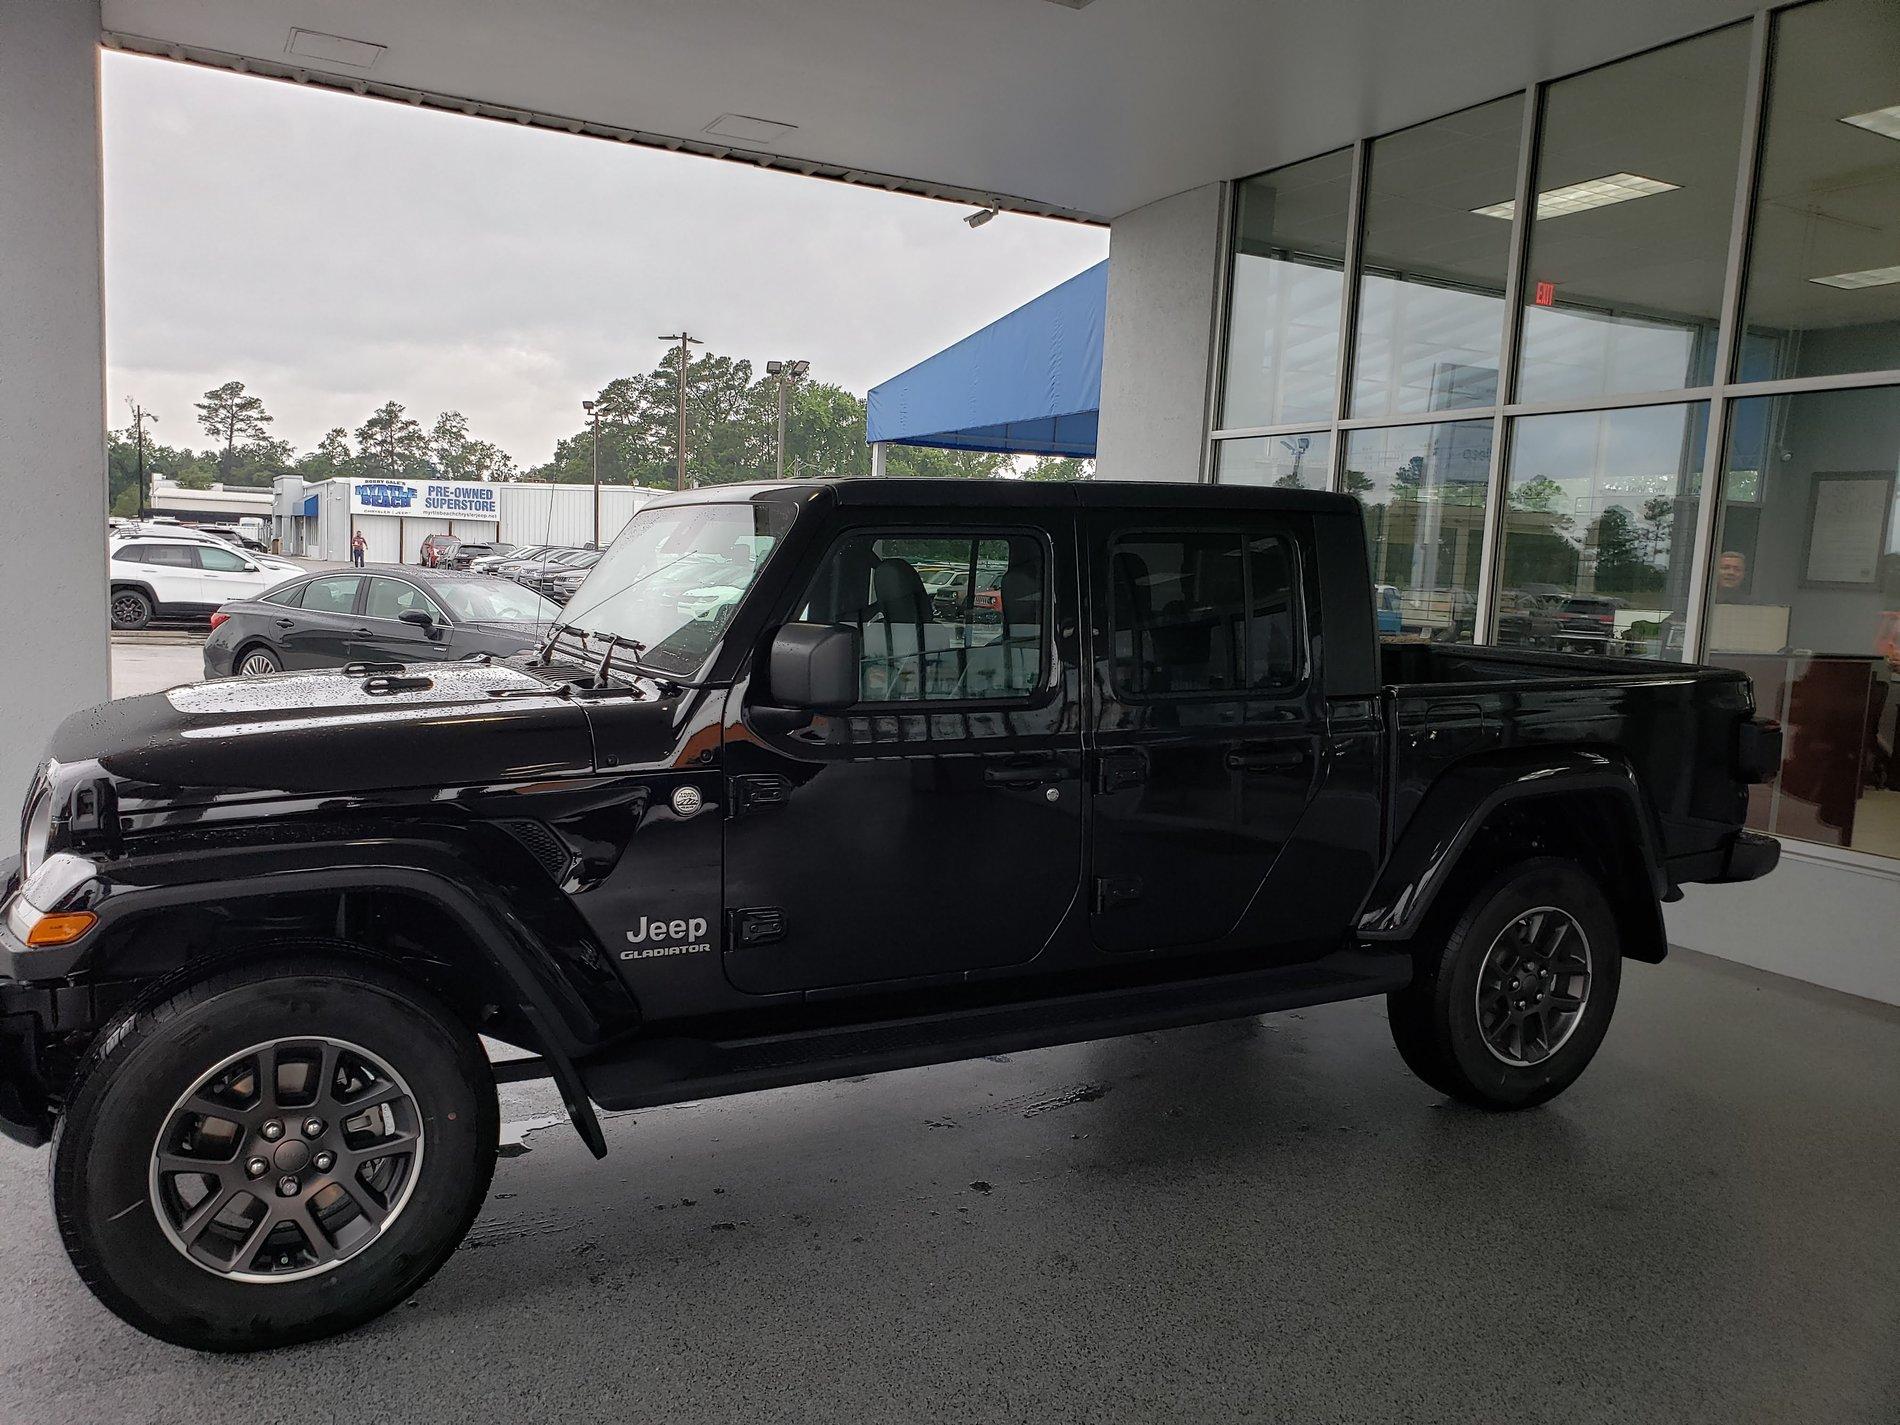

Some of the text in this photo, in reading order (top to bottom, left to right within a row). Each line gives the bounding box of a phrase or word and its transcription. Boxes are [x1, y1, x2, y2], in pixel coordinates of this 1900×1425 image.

[1536, 282, 1554, 306] EXIT
[355, 484, 418, 499] MYRTLE
[427, 485, 494, 500] PRE-OWNED
[360, 494, 412, 508] BEACH
[424, 497, 496, 512] SUPERSTORE
[626, 916, 708, 943] Jeep
[620, 943, 711, 960] GLADIATOR
